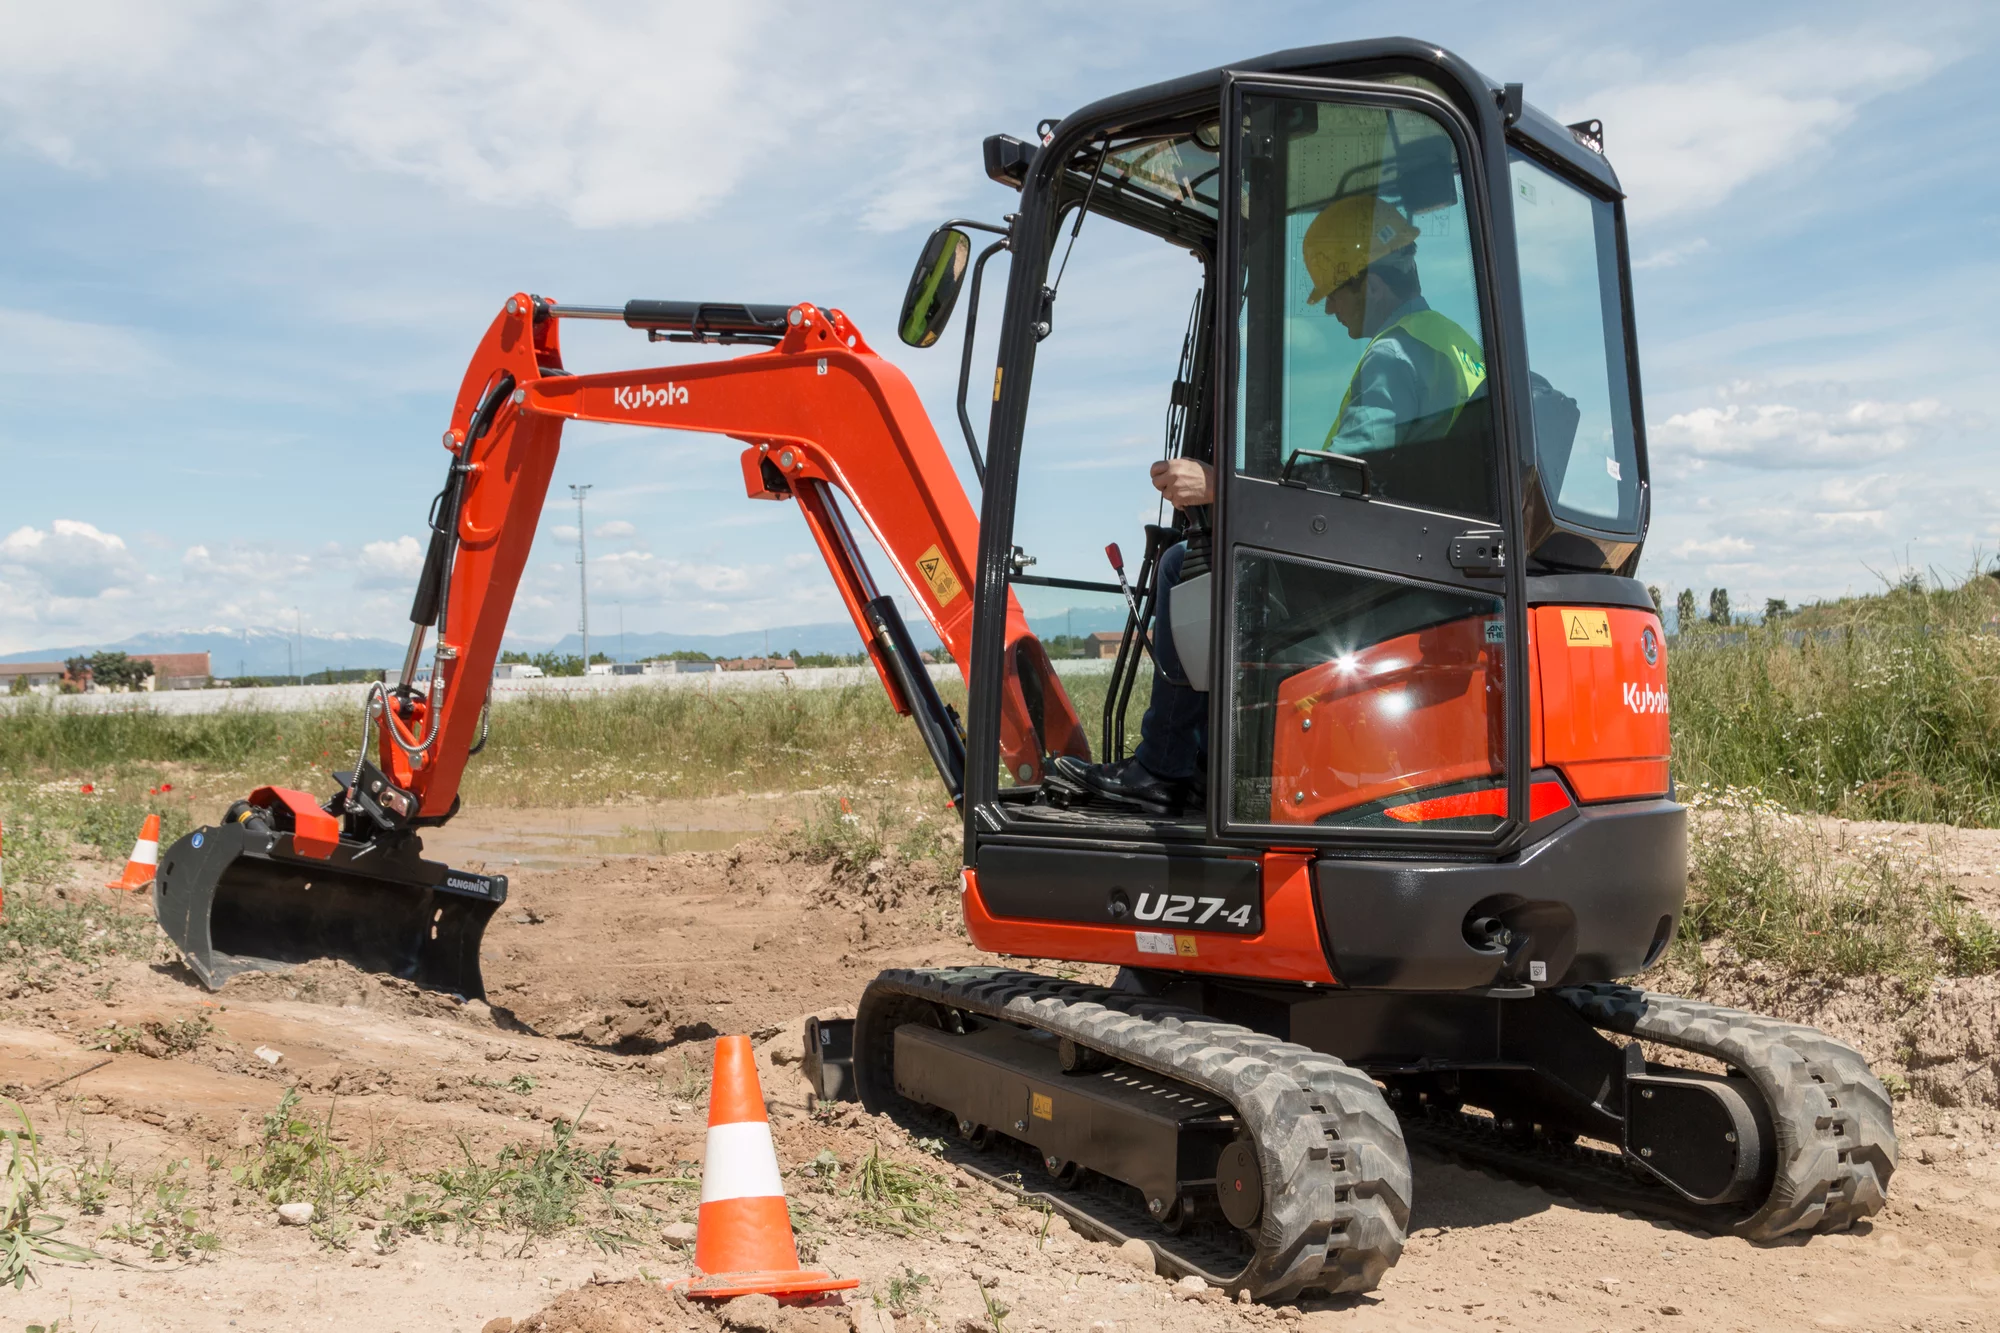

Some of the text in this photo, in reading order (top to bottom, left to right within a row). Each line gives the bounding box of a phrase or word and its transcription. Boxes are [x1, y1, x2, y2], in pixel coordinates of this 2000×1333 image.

[614, 381, 689, 410] Kubota
[1623, 682, 1669, 714] Kubota
[1134, 892, 1252, 927] U27-4
